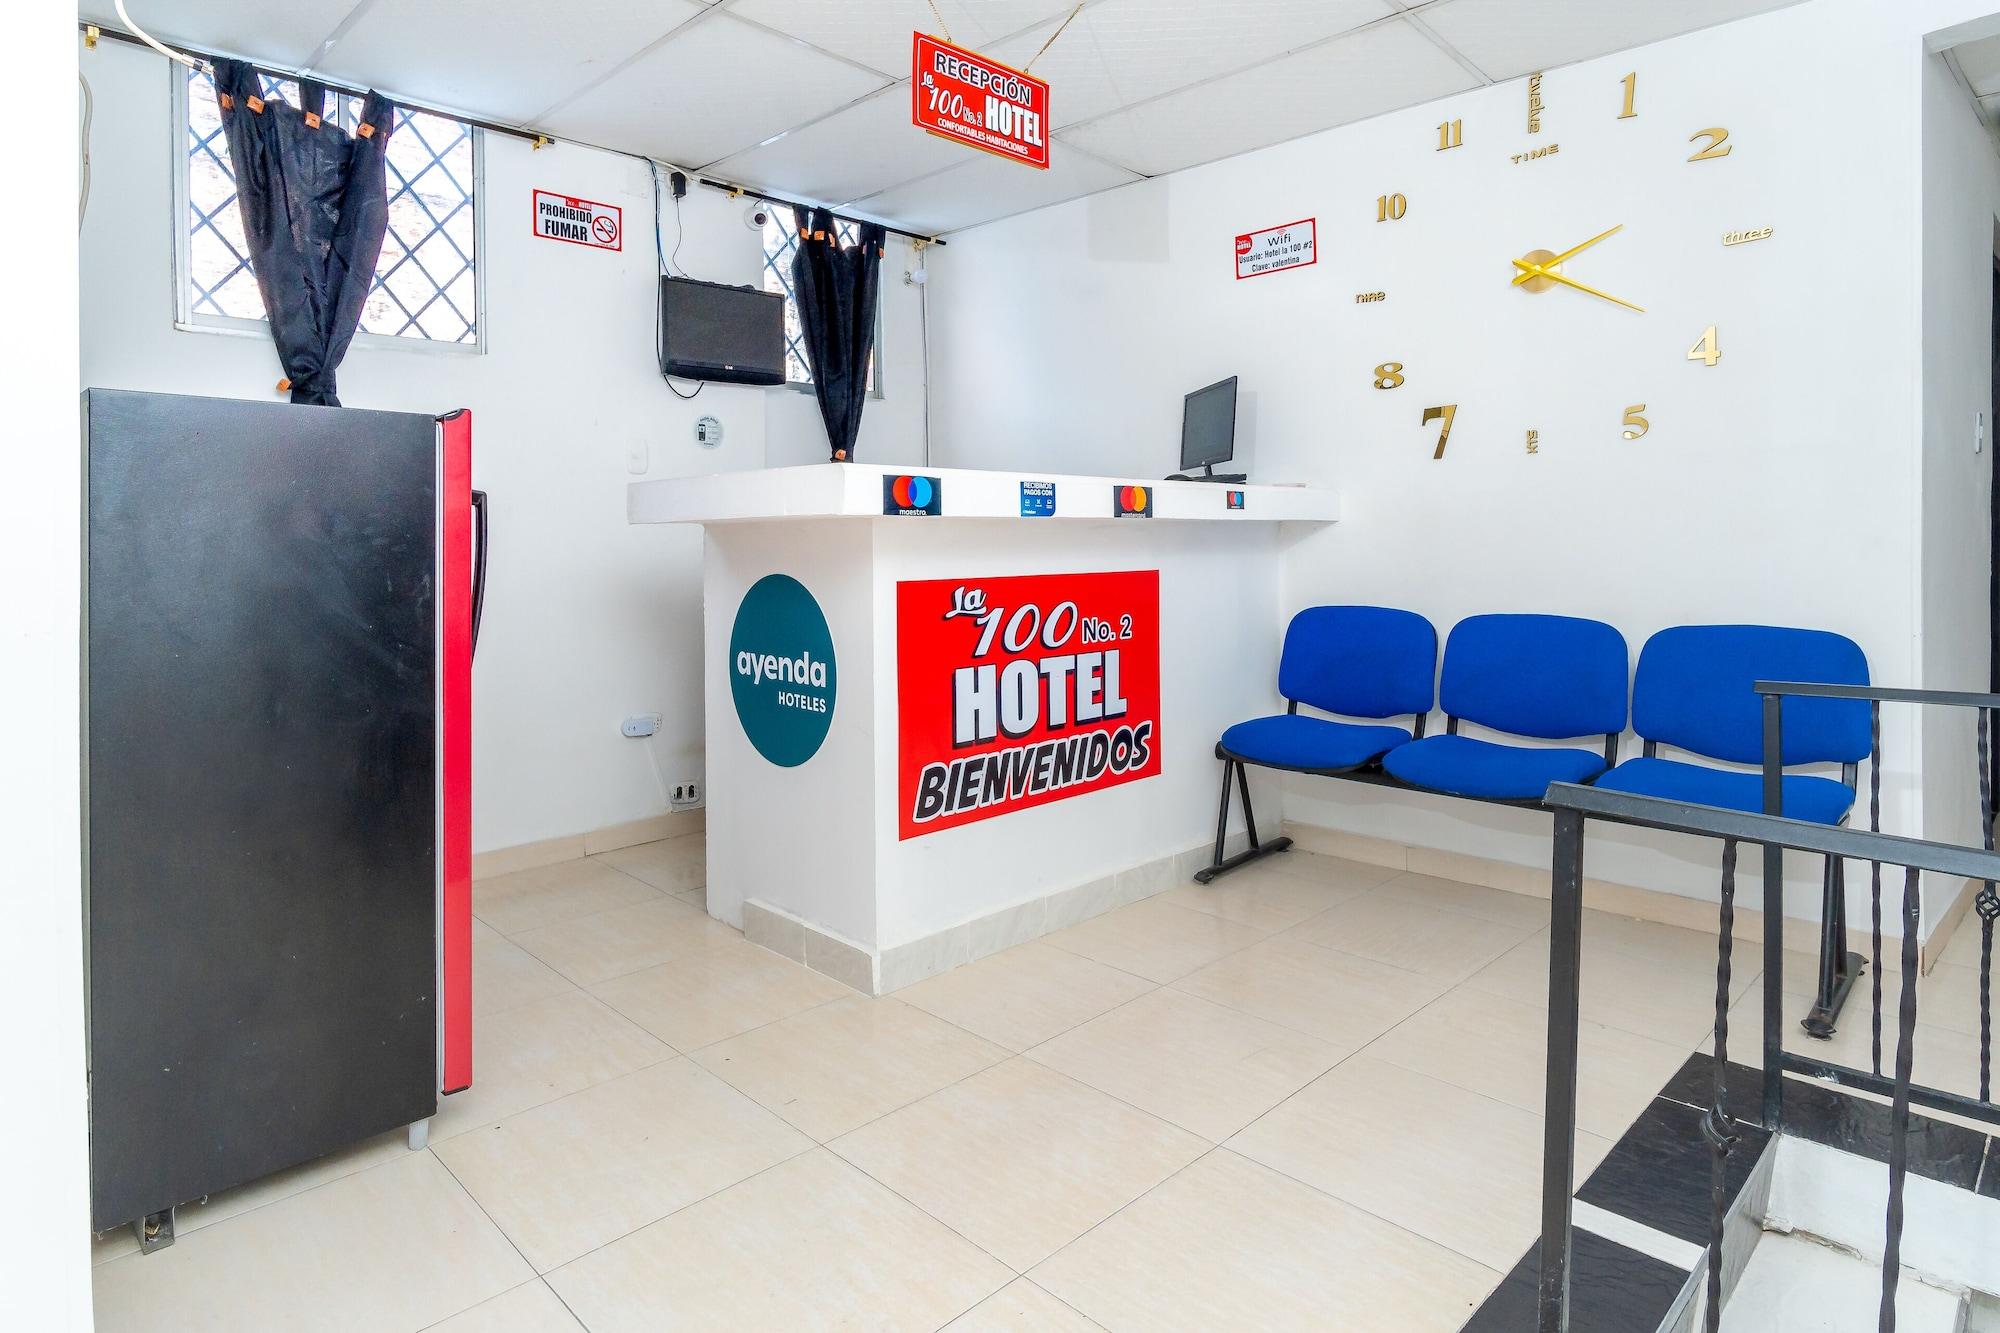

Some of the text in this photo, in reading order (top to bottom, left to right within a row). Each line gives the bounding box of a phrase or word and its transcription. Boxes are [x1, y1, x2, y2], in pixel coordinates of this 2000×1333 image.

[934, 50, 1032, 107] RECEPCIÓN
[1528, 71, 1545, 134] twelve
[1617, 72, 1638, 119] 1
[929, 86, 963, 119] 100
[976, 111, 983, 127] 2
[985, 95, 1043, 148] HOTEL
[937, 118, 1029, 155] CONFORTABLES HABITACIONES
[1436, 119, 1463, 151] 11
[1687, 127, 1733, 162] 2
[1511, 143, 1559, 164] TIME
[540, 202, 592, 224] PROHIBIDO
[1376, 192, 1407, 222] 10
[545, 219, 588, 242] FUMAR
[1267, 233, 1291, 247] Wifi
[1722, 226, 1773, 246] three
[1239, 253, 1263, 264] Usuario:
[1264, 248, 1281, 258] Hotel
[1290, 243, 1301, 253] 100
[1303, 240, 1313, 249] #2
[1251, 256, 1300, 272] Clave: valentina
[1355, 291, 1386, 304] nine
[1687, 325, 1721, 366] 4
[1374, 362, 1405, 390] 8
[1421, 404, 1458, 459] 7
[1622, 404, 1650, 440] 5
[1023, 481, 1053, 490] RECIBIMOS
[1041, 489, 1053, 497] CON
[944, 586, 988, 620] La
[972, 601, 1133, 658] 100 No. 2
[737, 651, 827, 688] ayenda
[778, 691, 826, 713] HOTELES
[952, 649, 1128, 749] HOTEL
[912, 720, 1153, 824] BIENVENIDOS
